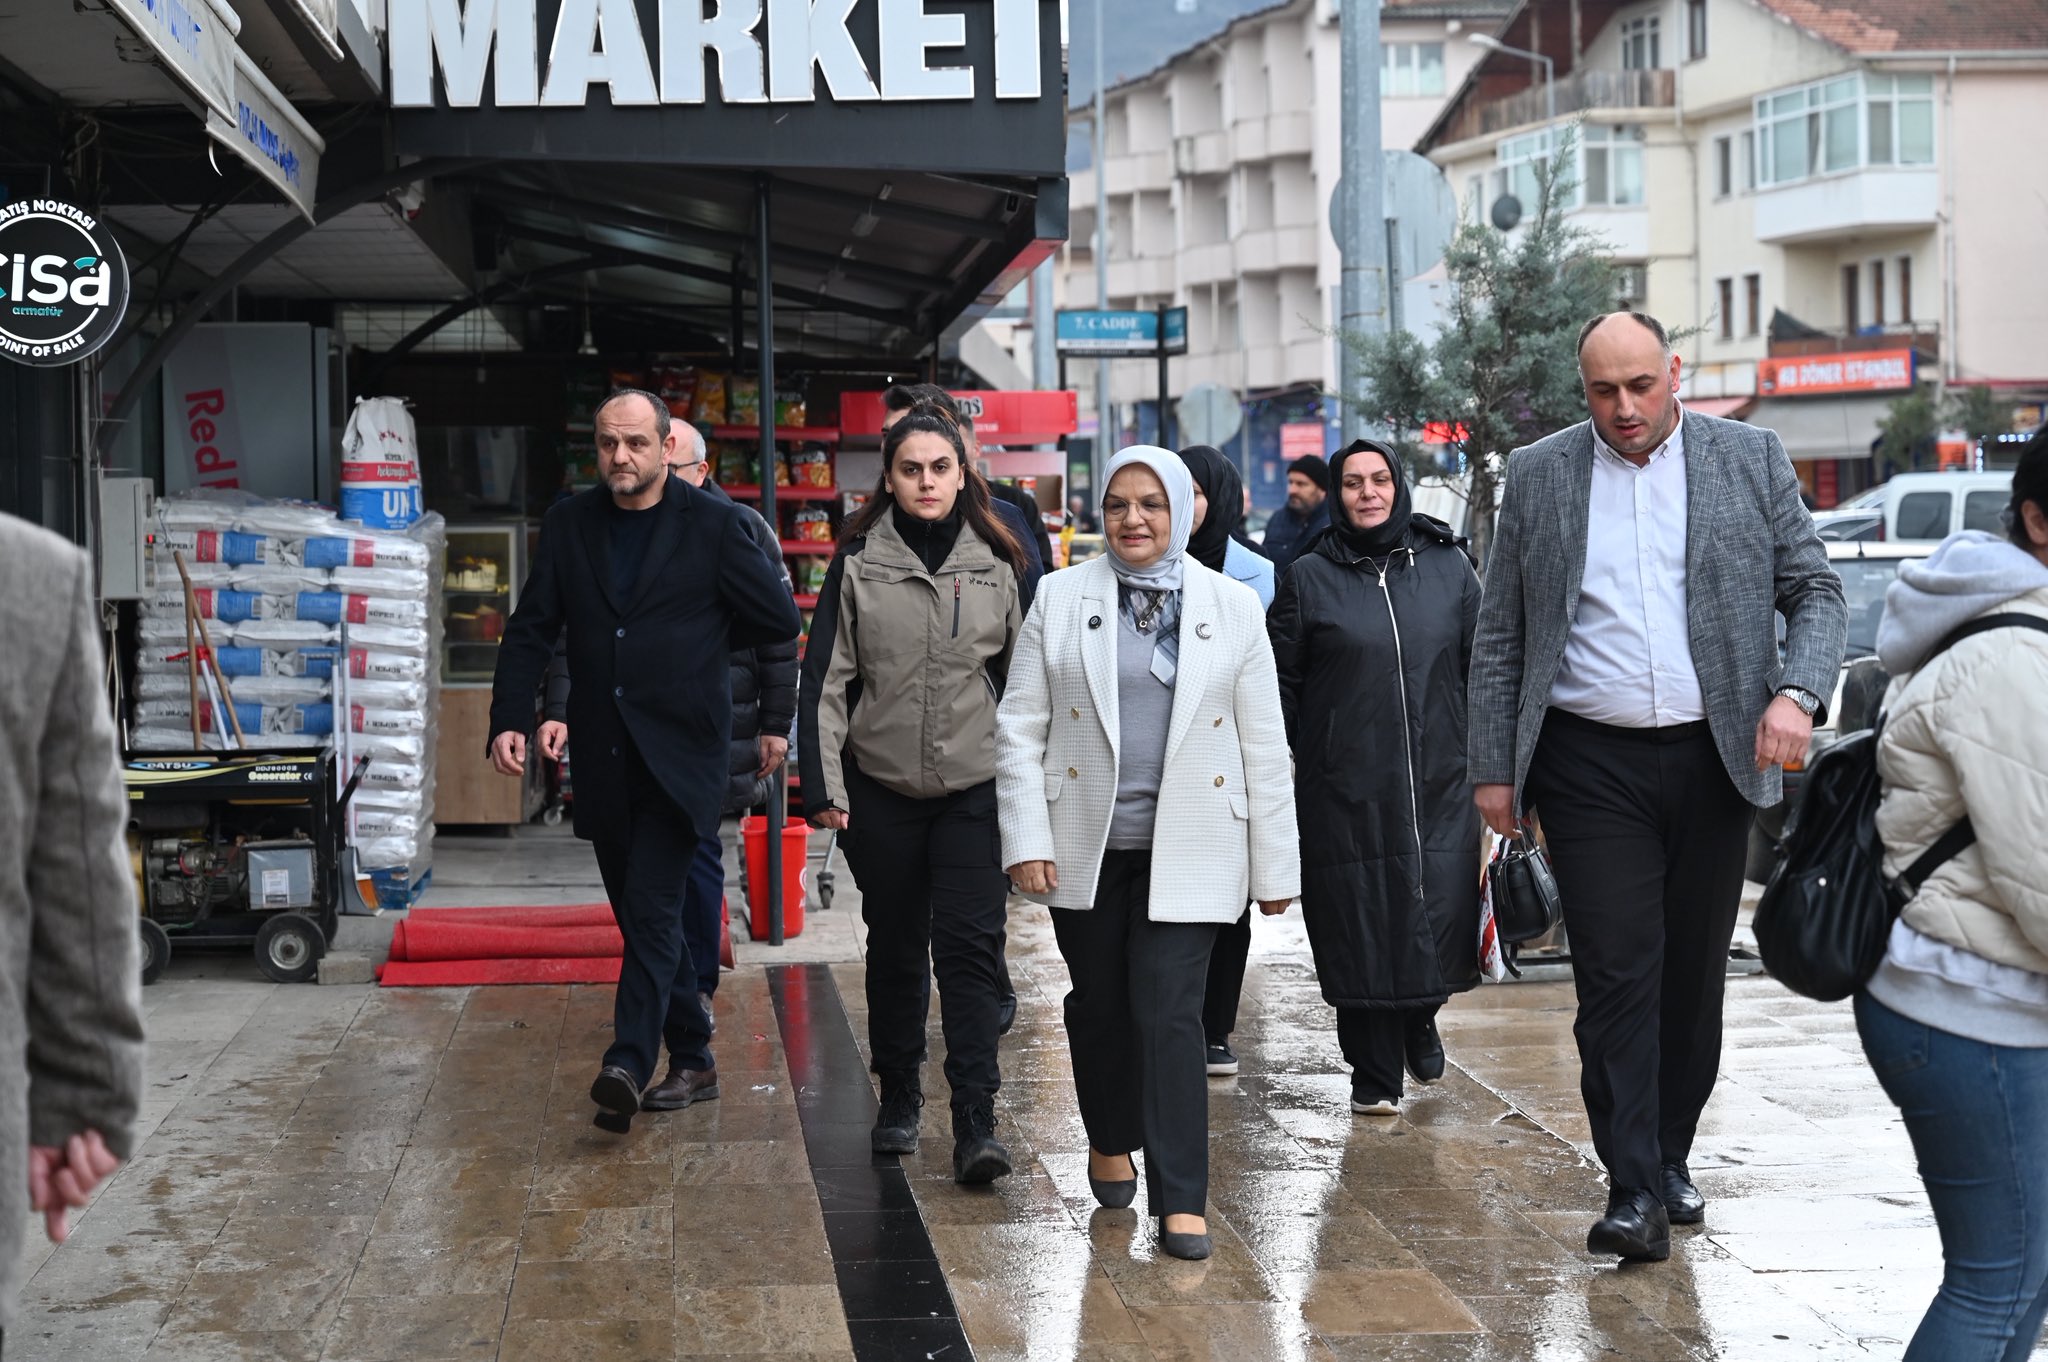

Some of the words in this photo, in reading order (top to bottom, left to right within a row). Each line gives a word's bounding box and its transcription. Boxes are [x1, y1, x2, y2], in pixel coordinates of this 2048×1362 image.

[0, 200, 30, 222] ATIŞ
[33, 199, 97, 231] NOKTASI
[12, 306, 63, 317] armatür
[1088, 316, 1140, 330] CADDE
[0, 335, 29, 356] OINT
[31, 345, 51, 357] OF
[53, 333, 86, 355] SALE
[1800, 361, 1843, 385] DÖNER
[1846, 357, 1906, 383] İSTANBUL
[185, 388, 237, 474] Red
[147, 762, 192, 770] DATSU
[248, 771, 301, 781] Generator
